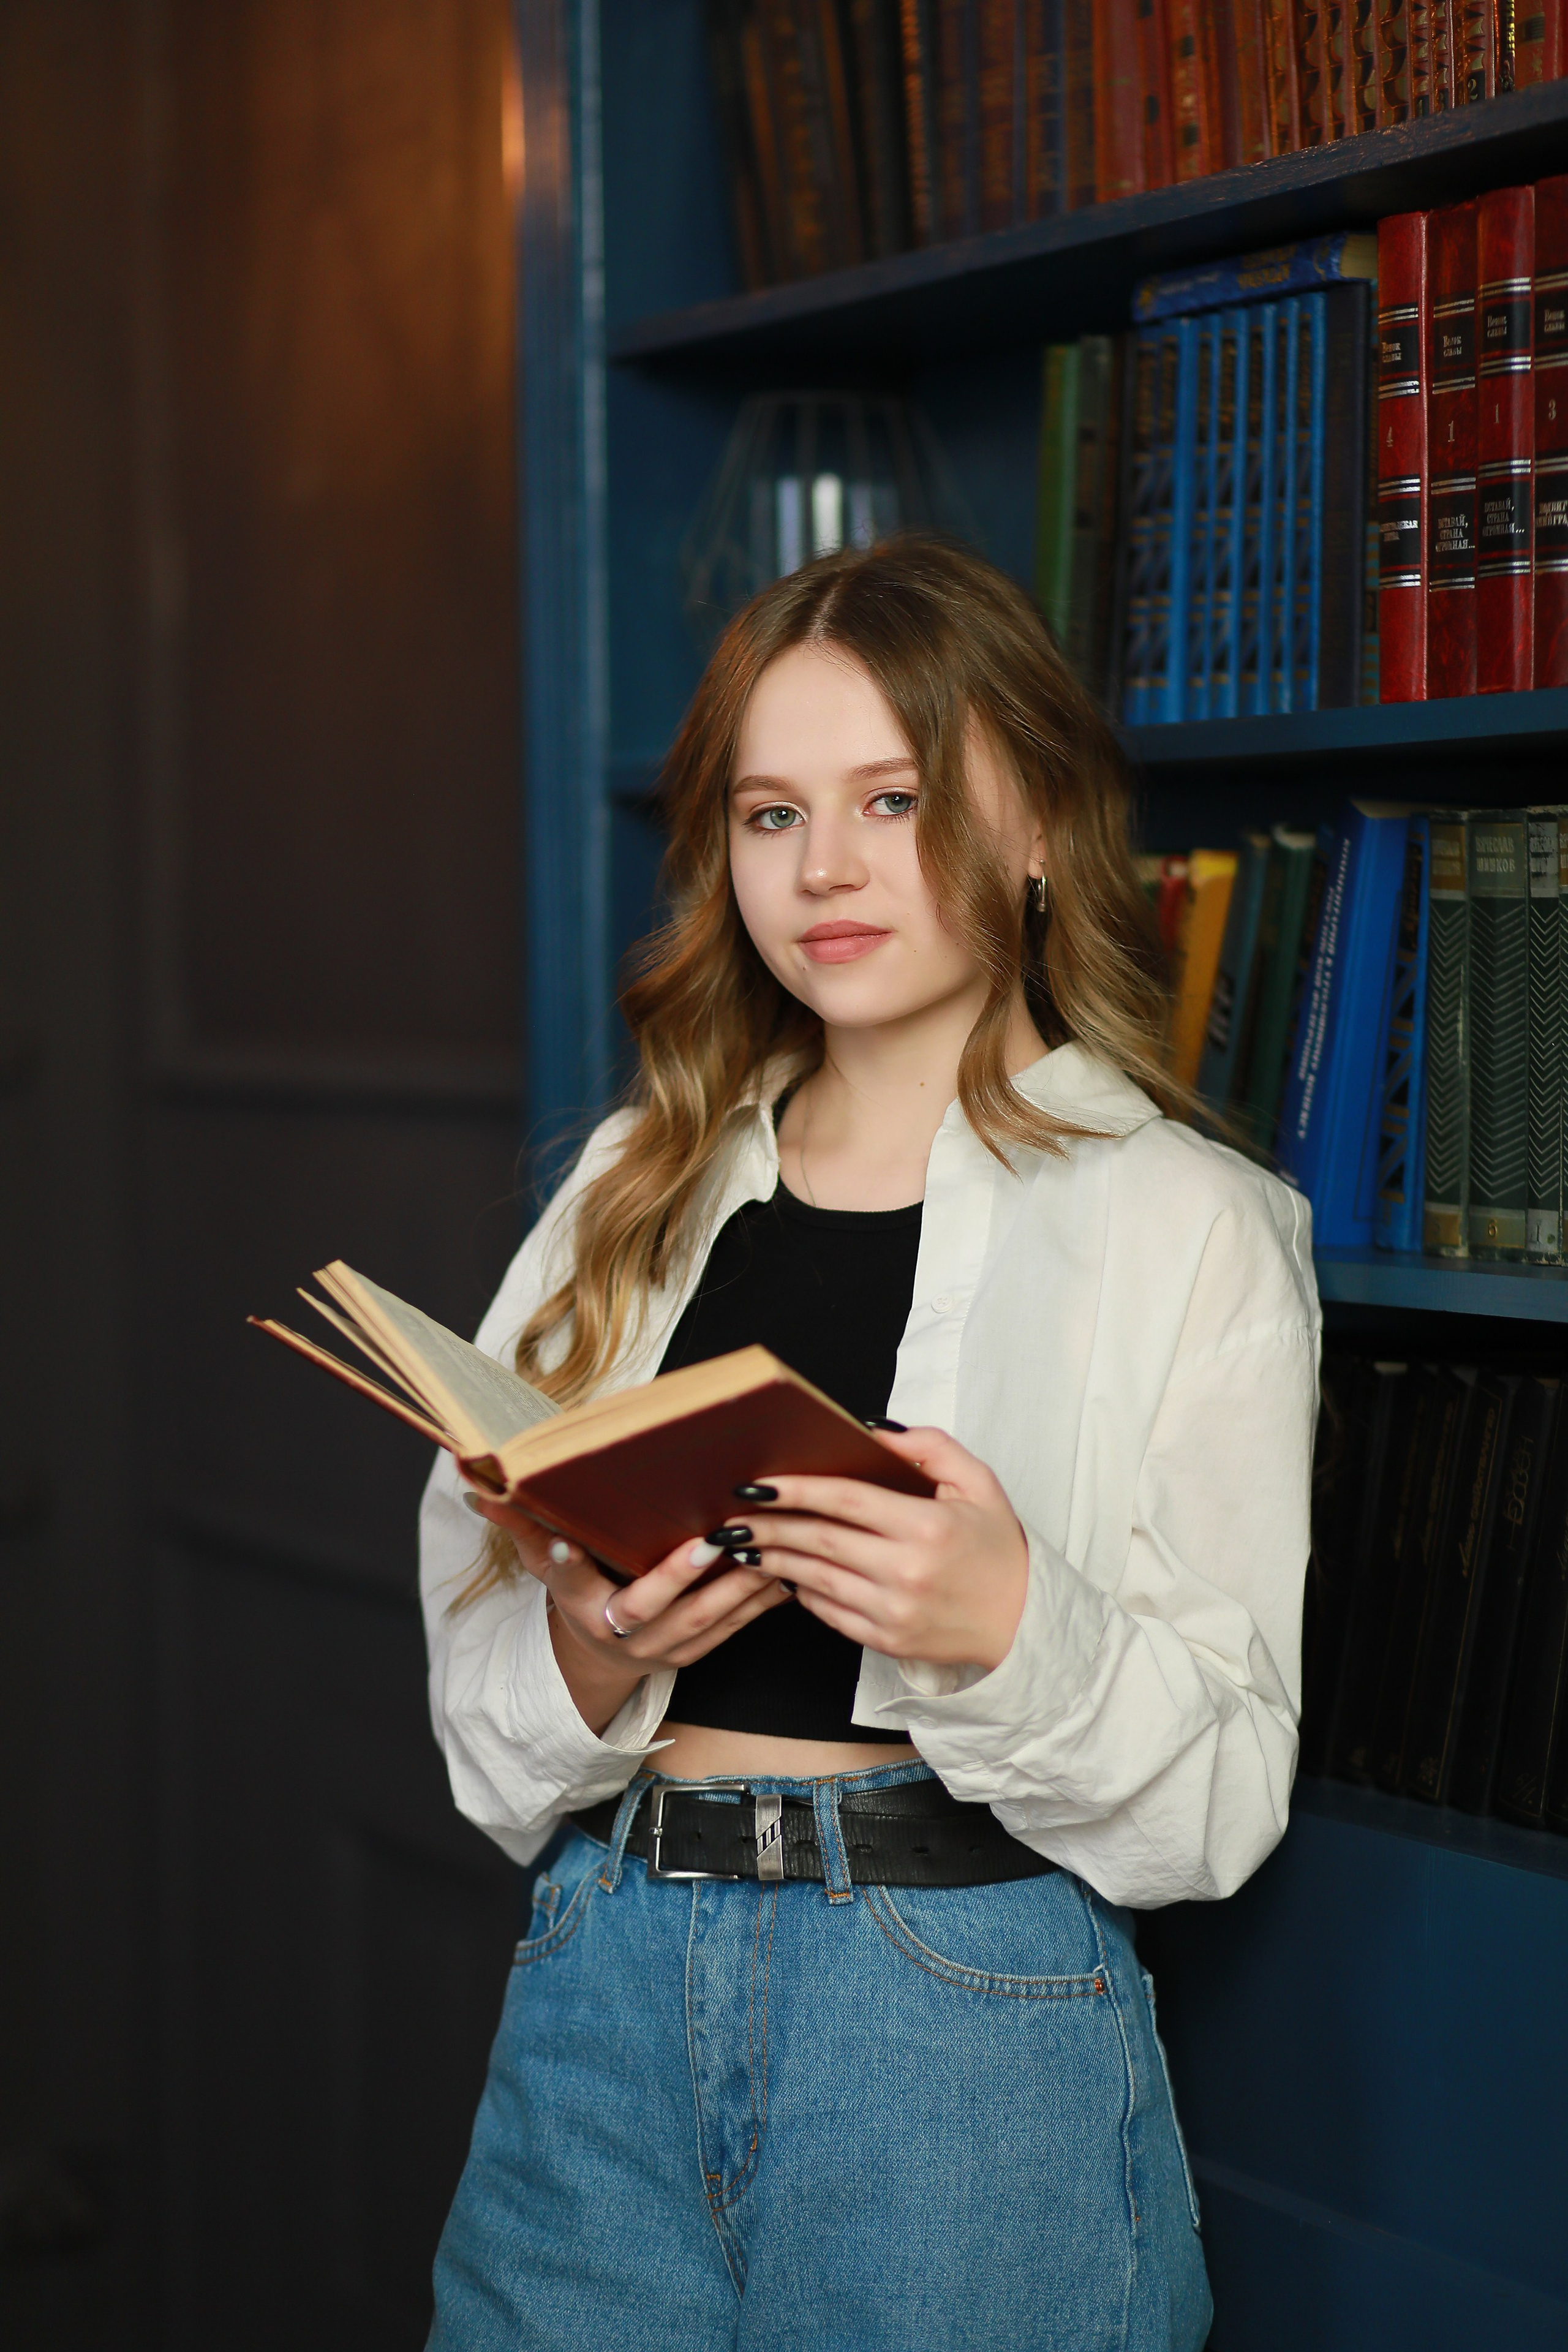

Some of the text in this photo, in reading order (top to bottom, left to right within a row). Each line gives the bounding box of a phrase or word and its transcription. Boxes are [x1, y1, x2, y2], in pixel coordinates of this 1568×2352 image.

[1443, 335, 1461, 347] Венок
[1443, 346, 1462, 357] славы
[1494, 404, 1499, 424] 1
[1548, 399, 1556, 421] 3
[1385, 426, 1393, 447] 4
[1448, 420, 1455, 442] 1
[1476, 858, 1515, 872] ШИШКОВ
[1488, 1219, 1498, 1238] 6
